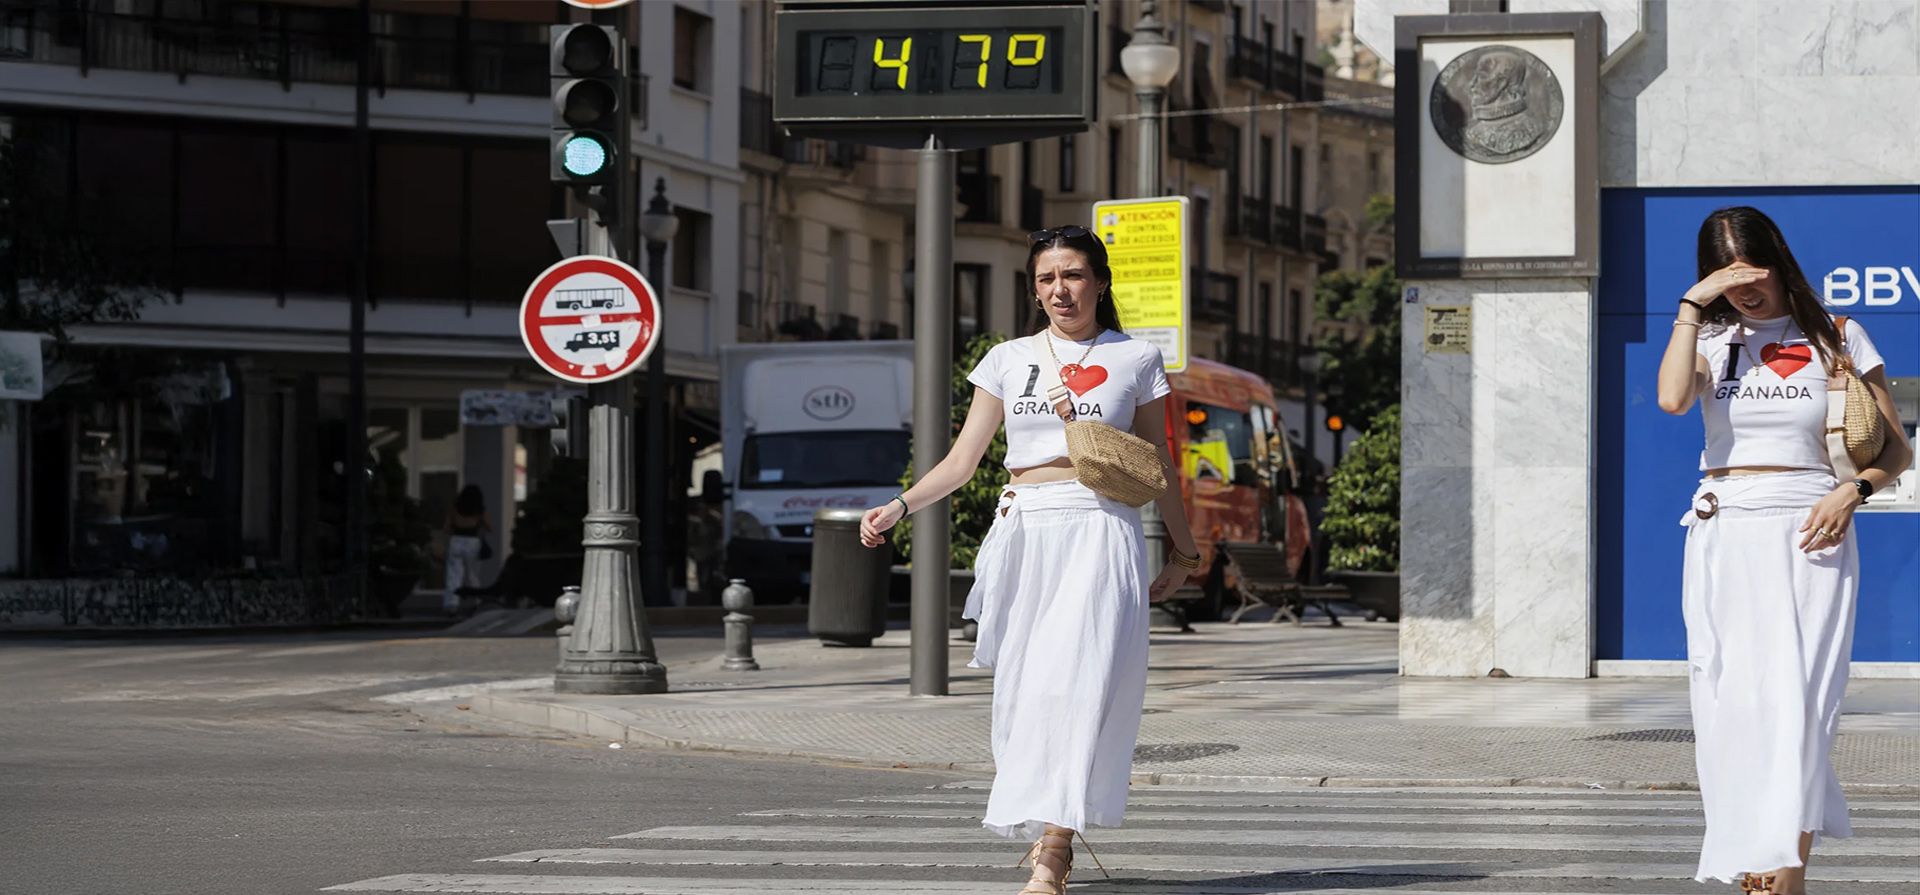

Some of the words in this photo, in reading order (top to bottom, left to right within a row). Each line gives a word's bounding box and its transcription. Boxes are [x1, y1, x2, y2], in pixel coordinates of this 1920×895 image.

[1119, 210, 1176, 222] ATENCIÓN
[1126, 224, 1168, 233] CONTROL
[1120, 236, 1130, 245] DE
[1133, 234, 1176, 244] ACCESOS
[1720, 342, 1745, 382] I
[1018, 364, 1041, 398] I
[1714, 385, 1813, 400] GRANADA
[811, 393, 849, 408] sth
